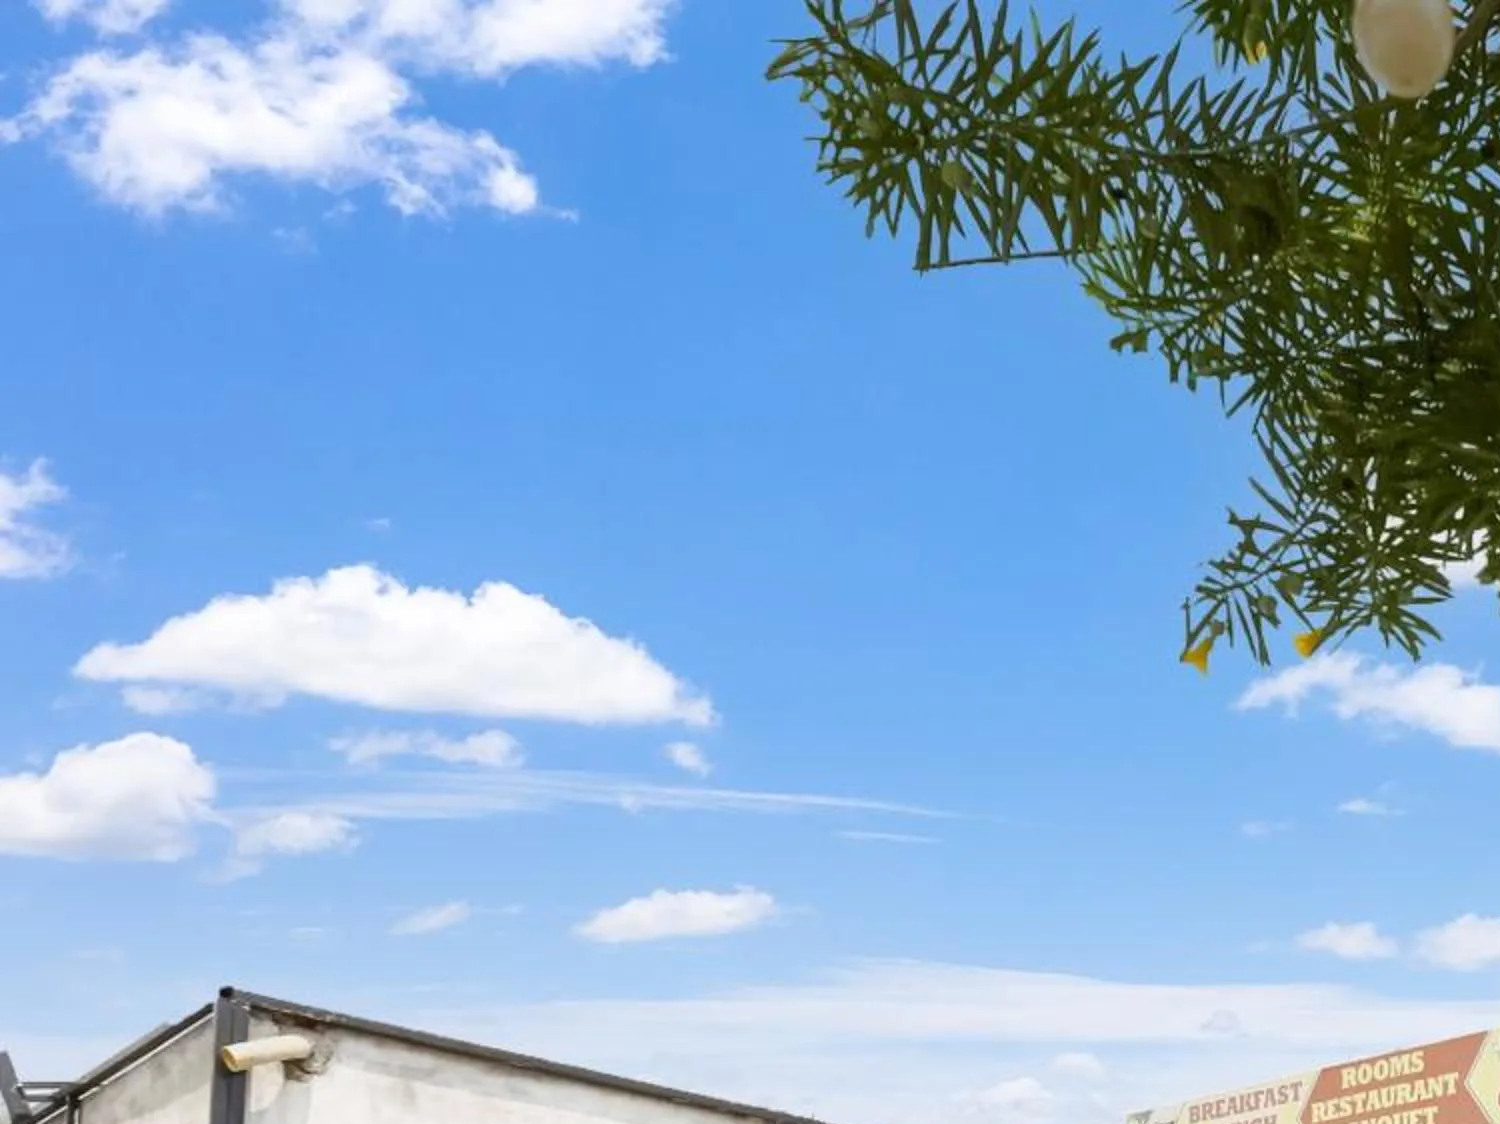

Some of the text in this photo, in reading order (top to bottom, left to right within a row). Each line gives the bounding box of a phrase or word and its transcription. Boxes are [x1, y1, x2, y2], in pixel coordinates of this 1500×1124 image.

[1340, 1051, 1425, 1090] ROOMS
[1188, 1081, 1303, 1124] BREAKFAST
[1310, 1071, 1460, 1123] RESTAURANT
